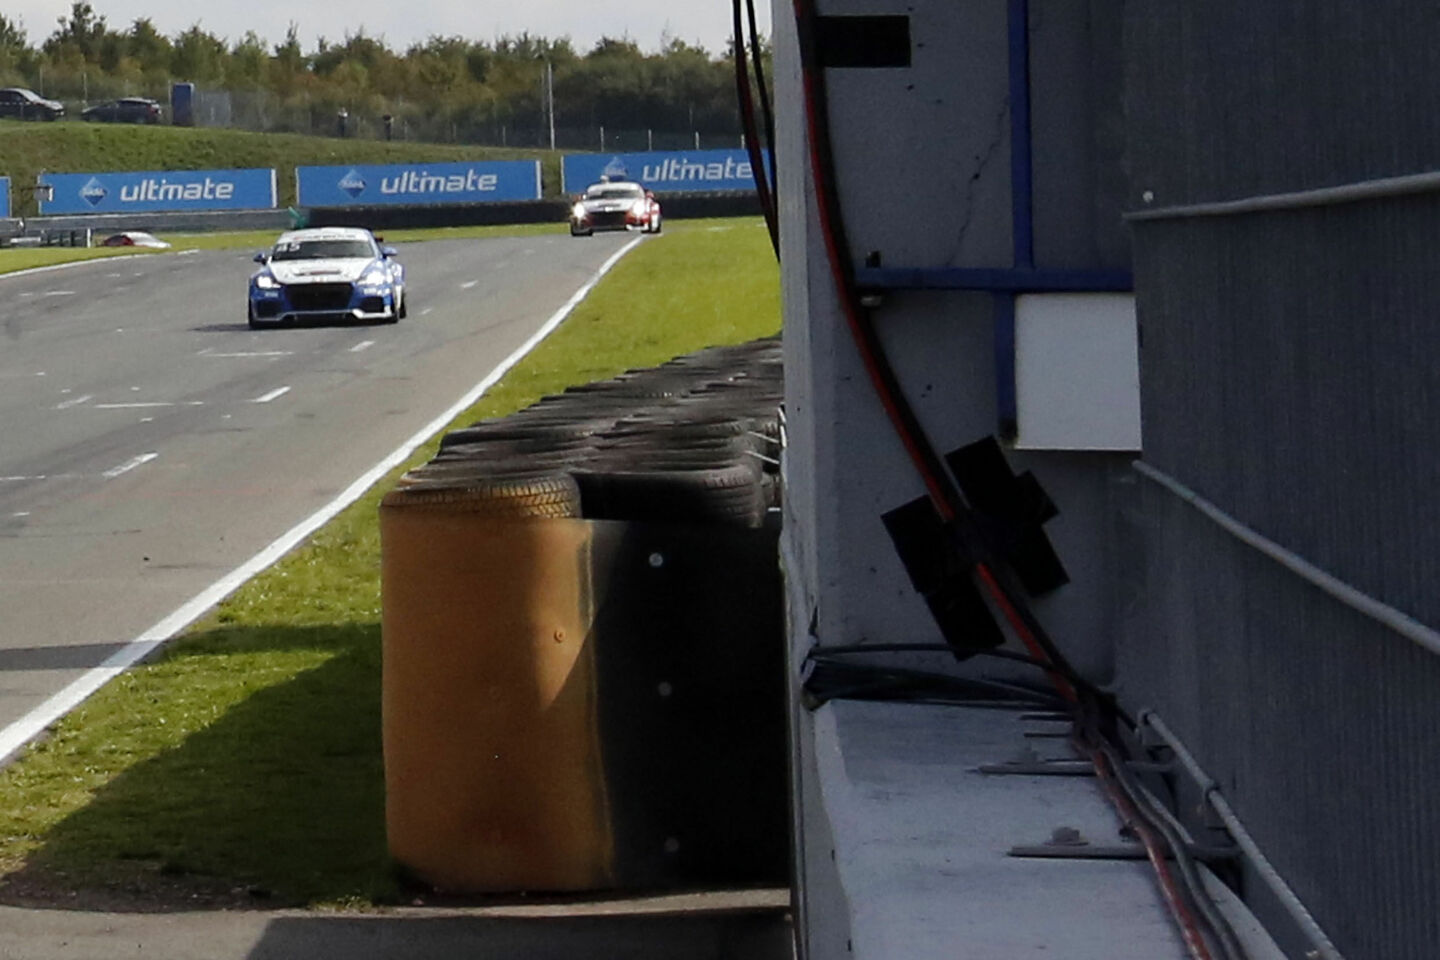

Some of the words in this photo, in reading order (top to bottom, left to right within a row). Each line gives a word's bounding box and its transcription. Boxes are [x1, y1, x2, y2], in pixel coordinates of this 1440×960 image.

[380, 168, 497, 194] ultimate
[642, 156, 753, 182] ultimate
[119, 177, 234, 202] ultimate
